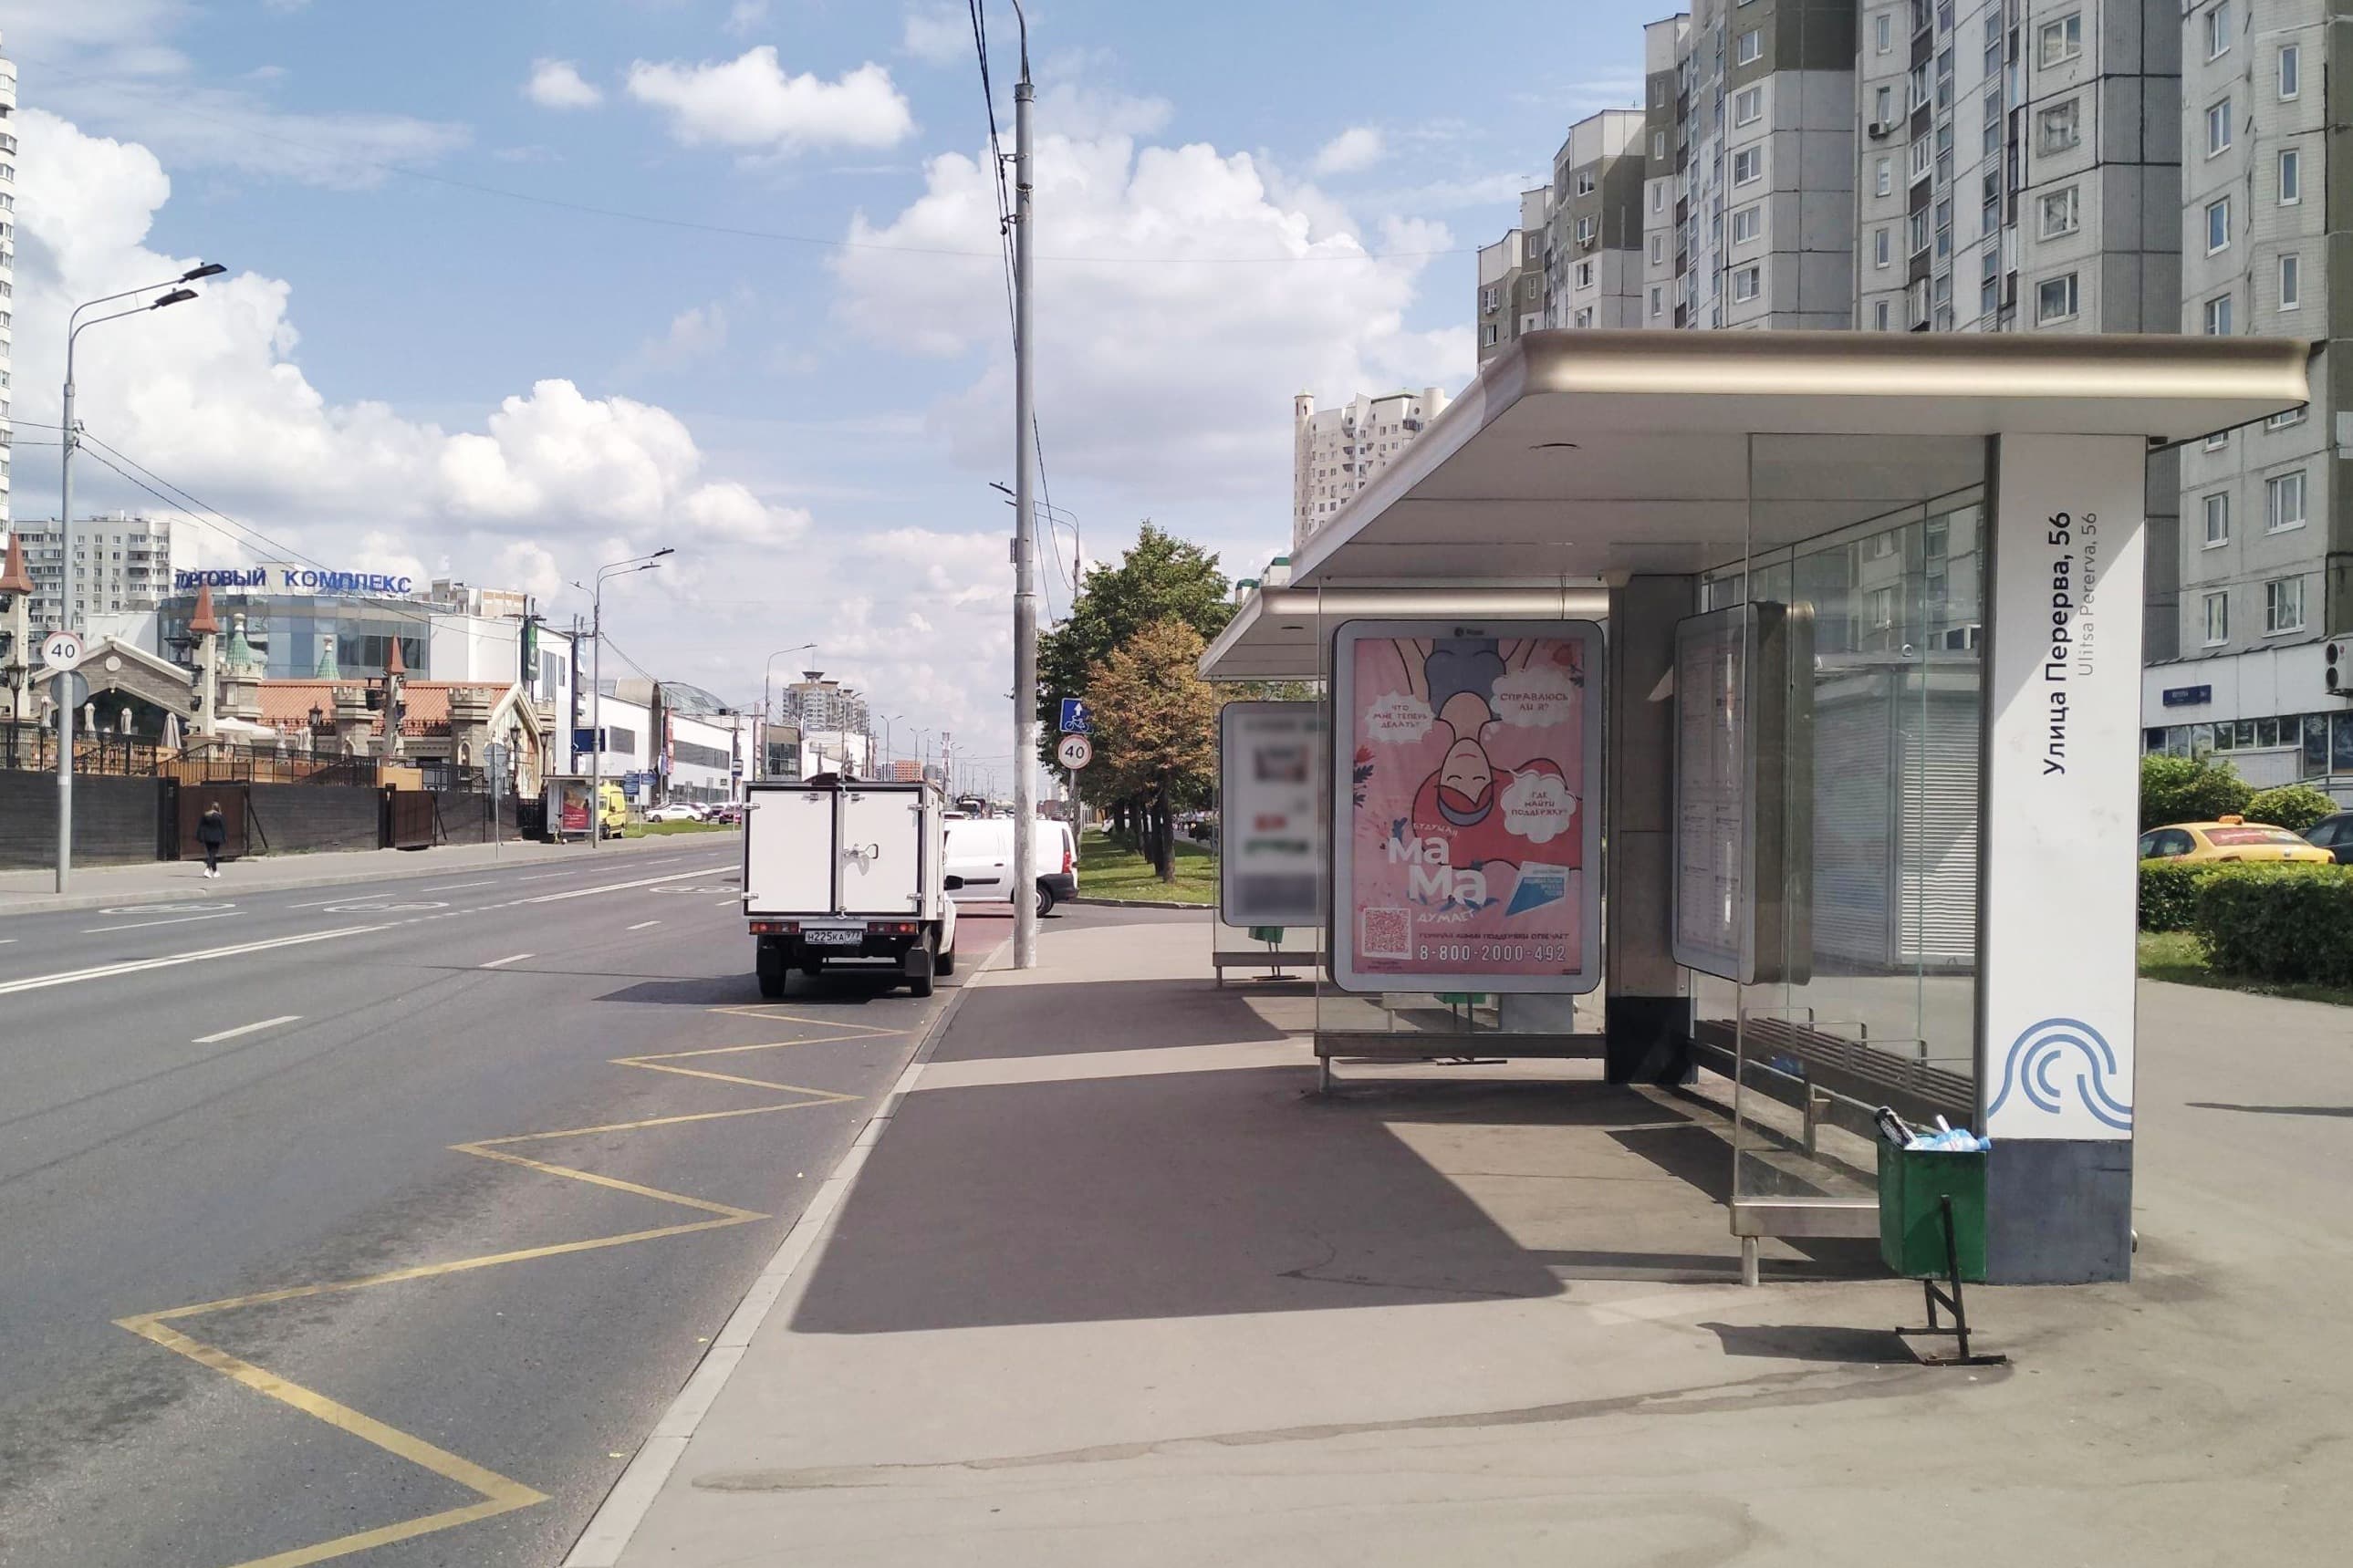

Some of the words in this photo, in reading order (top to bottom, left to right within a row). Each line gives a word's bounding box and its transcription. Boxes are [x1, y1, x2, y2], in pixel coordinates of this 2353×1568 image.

[2047, 511, 2071, 546] 56
[2080, 512, 2098, 535] 56
[175, 566, 266, 589] ТОРГОВЫЙ
[285, 570, 411, 593] КОМПЛЕКС
[2079, 540, 2098, 617] Pererva,
[2045, 553, 2074, 681] Перерва,
[51, 642, 75, 659] 40
[2077, 621, 2096, 677] Ulitsa
[2043, 691, 2069, 775] Улица
[1065, 745, 1085, 759] 40
